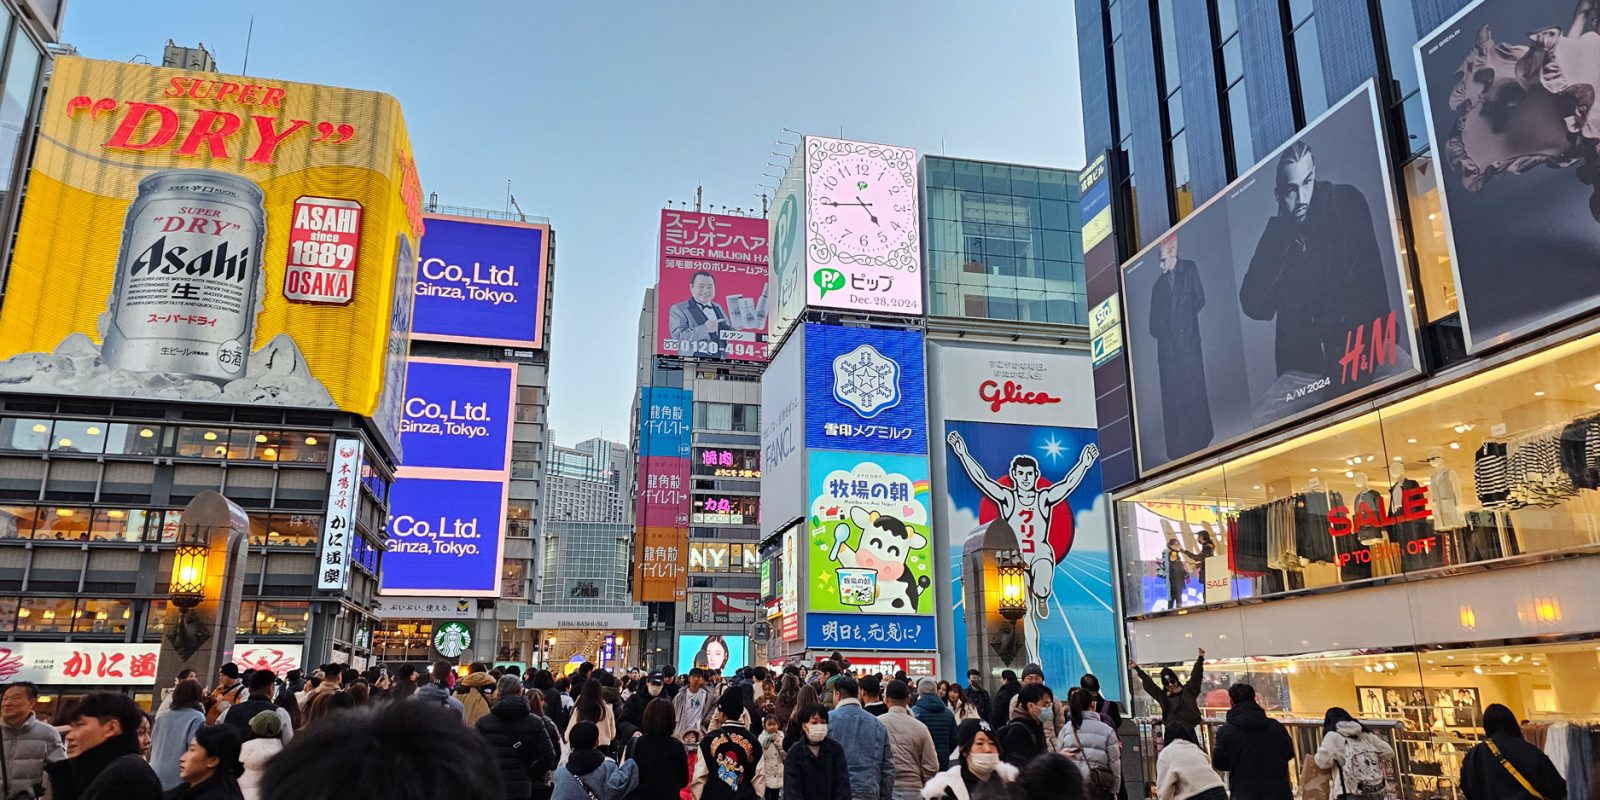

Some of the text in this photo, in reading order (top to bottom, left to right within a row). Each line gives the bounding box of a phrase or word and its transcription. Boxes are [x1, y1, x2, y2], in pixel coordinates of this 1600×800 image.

[163, 76, 286, 109] SUPER
[837, 165, 851, 179] 11
[856, 164, 870, 176] 12
[878, 171, 885, 182] 1
[823, 175, 839, 191] 10
[888, 186, 900, 196] 2
[820, 196, 832, 206] 9
[893, 204, 906, 213] 3
[179, 207, 221, 218] SUPER
[294, 205, 358, 234] ASAHI
[825, 214, 838, 225] 8
[665, 212, 732, 231] スーパー
[890, 220, 902, 231] 4
[310, 231, 340, 243] since
[665, 229, 769, 251] ミリオンヘア
[841, 228, 853, 239] 7
[859, 235, 869, 247] 6
[877, 231, 888, 244] 5
[130, 235, 249, 283] Asahi
[292, 240, 354, 269] 1889
[665, 245, 705, 257] SUPER
[708, 251, 751, 261] MILLION
[171, 282, 201, 300] 生
[287, 270, 348, 298] OSAKA
[851, 272, 895, 293] ピップ
[849, 294, 918, 309] Dec. 28, 2024
[147, 314, 217, 327] スーパードライ
[160, 347, 191, 356] 生ビール
[1338, 310, 1397, 385] H&M
[979, 380, 1062, 413] Glico
[1285, 377, 1331, 403] A/W 2024
[823, 422, 913, 440] 雪印メグミルク
[765, 423, 796, 476] FANCL
[702, 450, 734, 467] 焼肉
[334, 462, 352, 510] 本場の味
[829, 479, 909, 502] 牧場の朝
[1327, 486, 1433, 537] SALE
[1018, 507, 1036, 554] グリコ
[1352, 549, 1371, 564] TO
[1407, 537, 1437, 555] OFF
[1206, 577, 1229, 590] SALE
